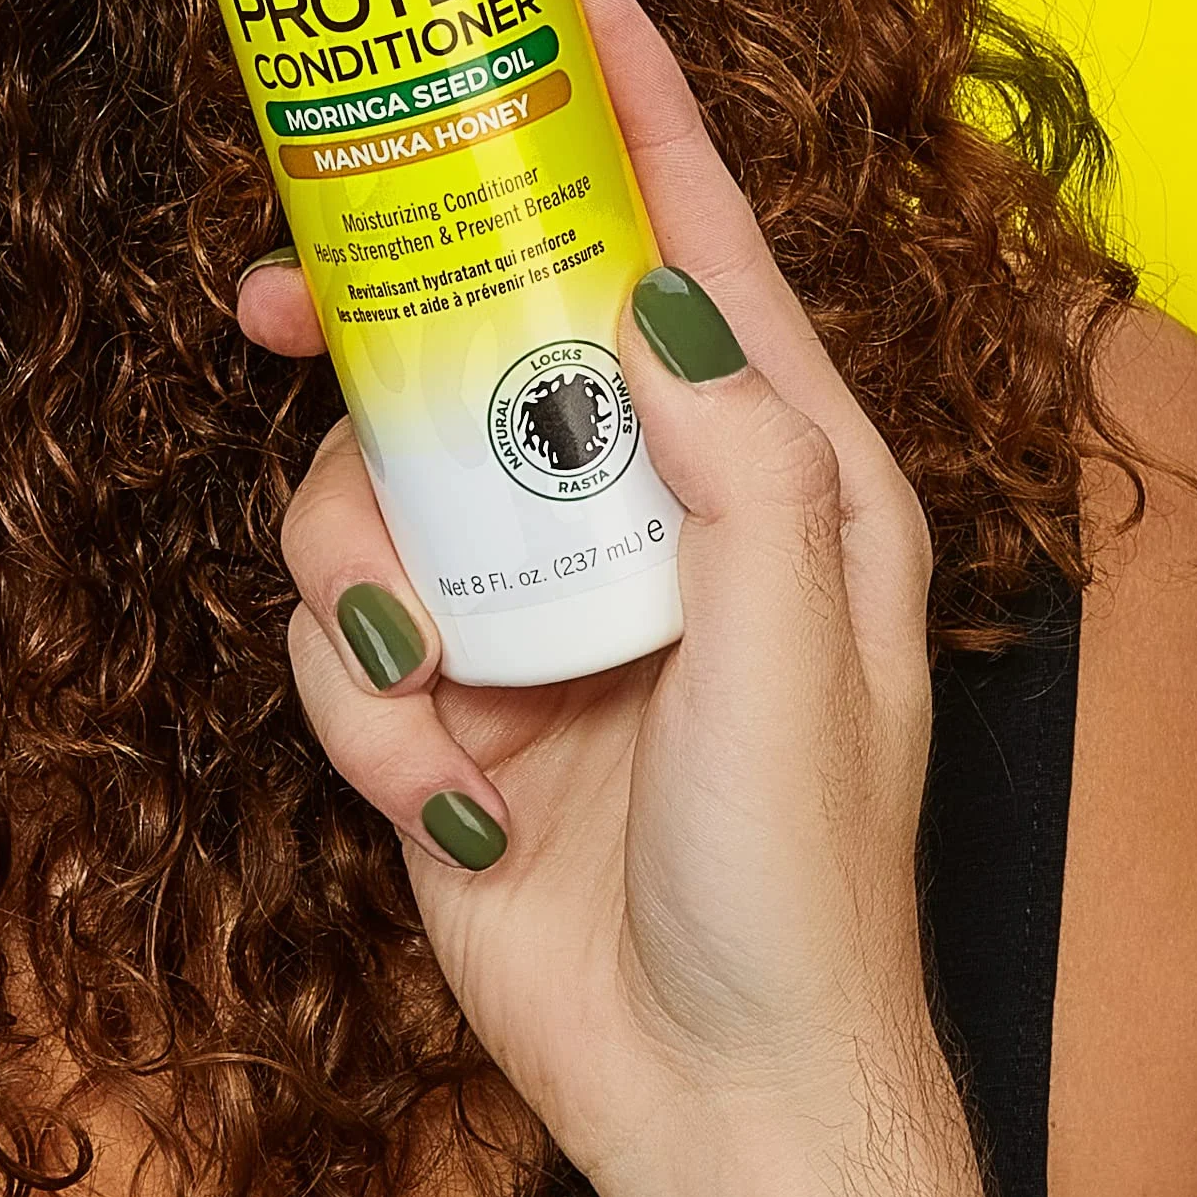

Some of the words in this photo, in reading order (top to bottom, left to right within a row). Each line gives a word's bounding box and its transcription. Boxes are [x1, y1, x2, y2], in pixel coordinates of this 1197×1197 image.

[285, 92, 409, 133] MORINGA
[414, 66, 488, 110] SEED
[492, 49, 535, 79] OIL
[313, 132, 433, 173] MANUKA
[435, 93, 530, 149] HONEY
[313, 242, 347, 267] Helps
[348, 234, 435, 263] Strengthen
[440, 226, 454, 245] &
[456, 207, 522, 241] Prevent
[524, 174, 592, 217] Breakage
[341, 201, 441, 234] Moisturizing
[443, 166, 540, 213] Conditioner
[336, 307, 352, 323] les
[353, 301, 401, 323] cheveux
[403, 299, 418, 318] et
[419, 294, 450, 316] aide
[455, 291, 463, 307] à
[466, 273, 526, 307] prévenir
[528, 264, 550, 286] les
[551, 237, 605, 275] cassures
[347, 277, 420, 301] Revitalisant
[422, 258, 493, 291] hydratant
[495, 249, 518, 273] qui
[520, 228, 578, 263] renforce
[530, 348, 583, 372] LOCKS
[495, 396, 523, 472] NATURAL
[611, 371, 633, 435] TWISTS
[558, 469, 610, 494] RASTA
[438, 577, 469, 598] Net
[471, 575, 485, 595] 8
[488, 572, 514, 593] Fl.
[519, 569, 548, 587] oz.
[553, 547, 598, 580] (237
[605, 531, 643, 561] mL)
